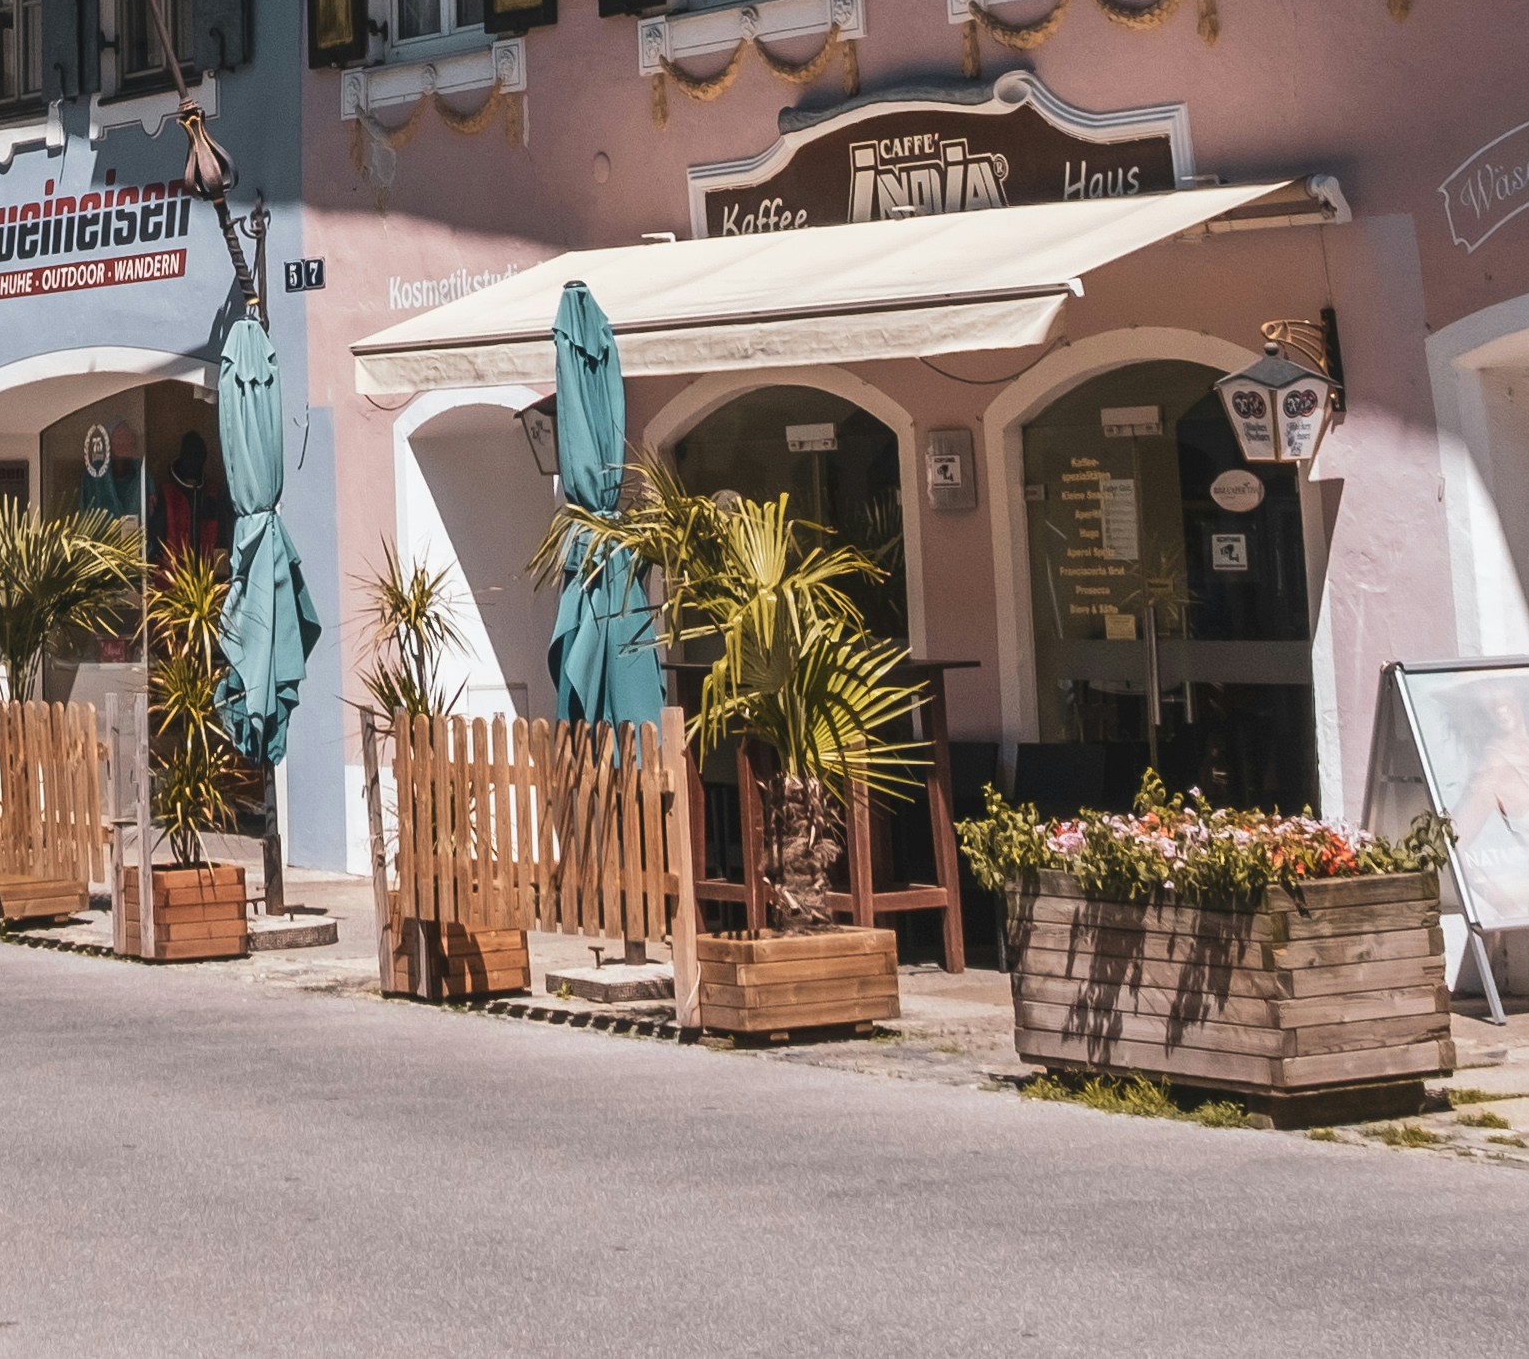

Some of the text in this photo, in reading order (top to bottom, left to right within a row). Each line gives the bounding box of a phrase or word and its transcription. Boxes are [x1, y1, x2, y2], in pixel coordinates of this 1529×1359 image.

[722, 159, 1141, 236] Kaffee Haus
[41, 262, 105, 292] OUTDOOR
[114, 253, 181, 282] WANDERN
[289, 261, 319, 287] 57
